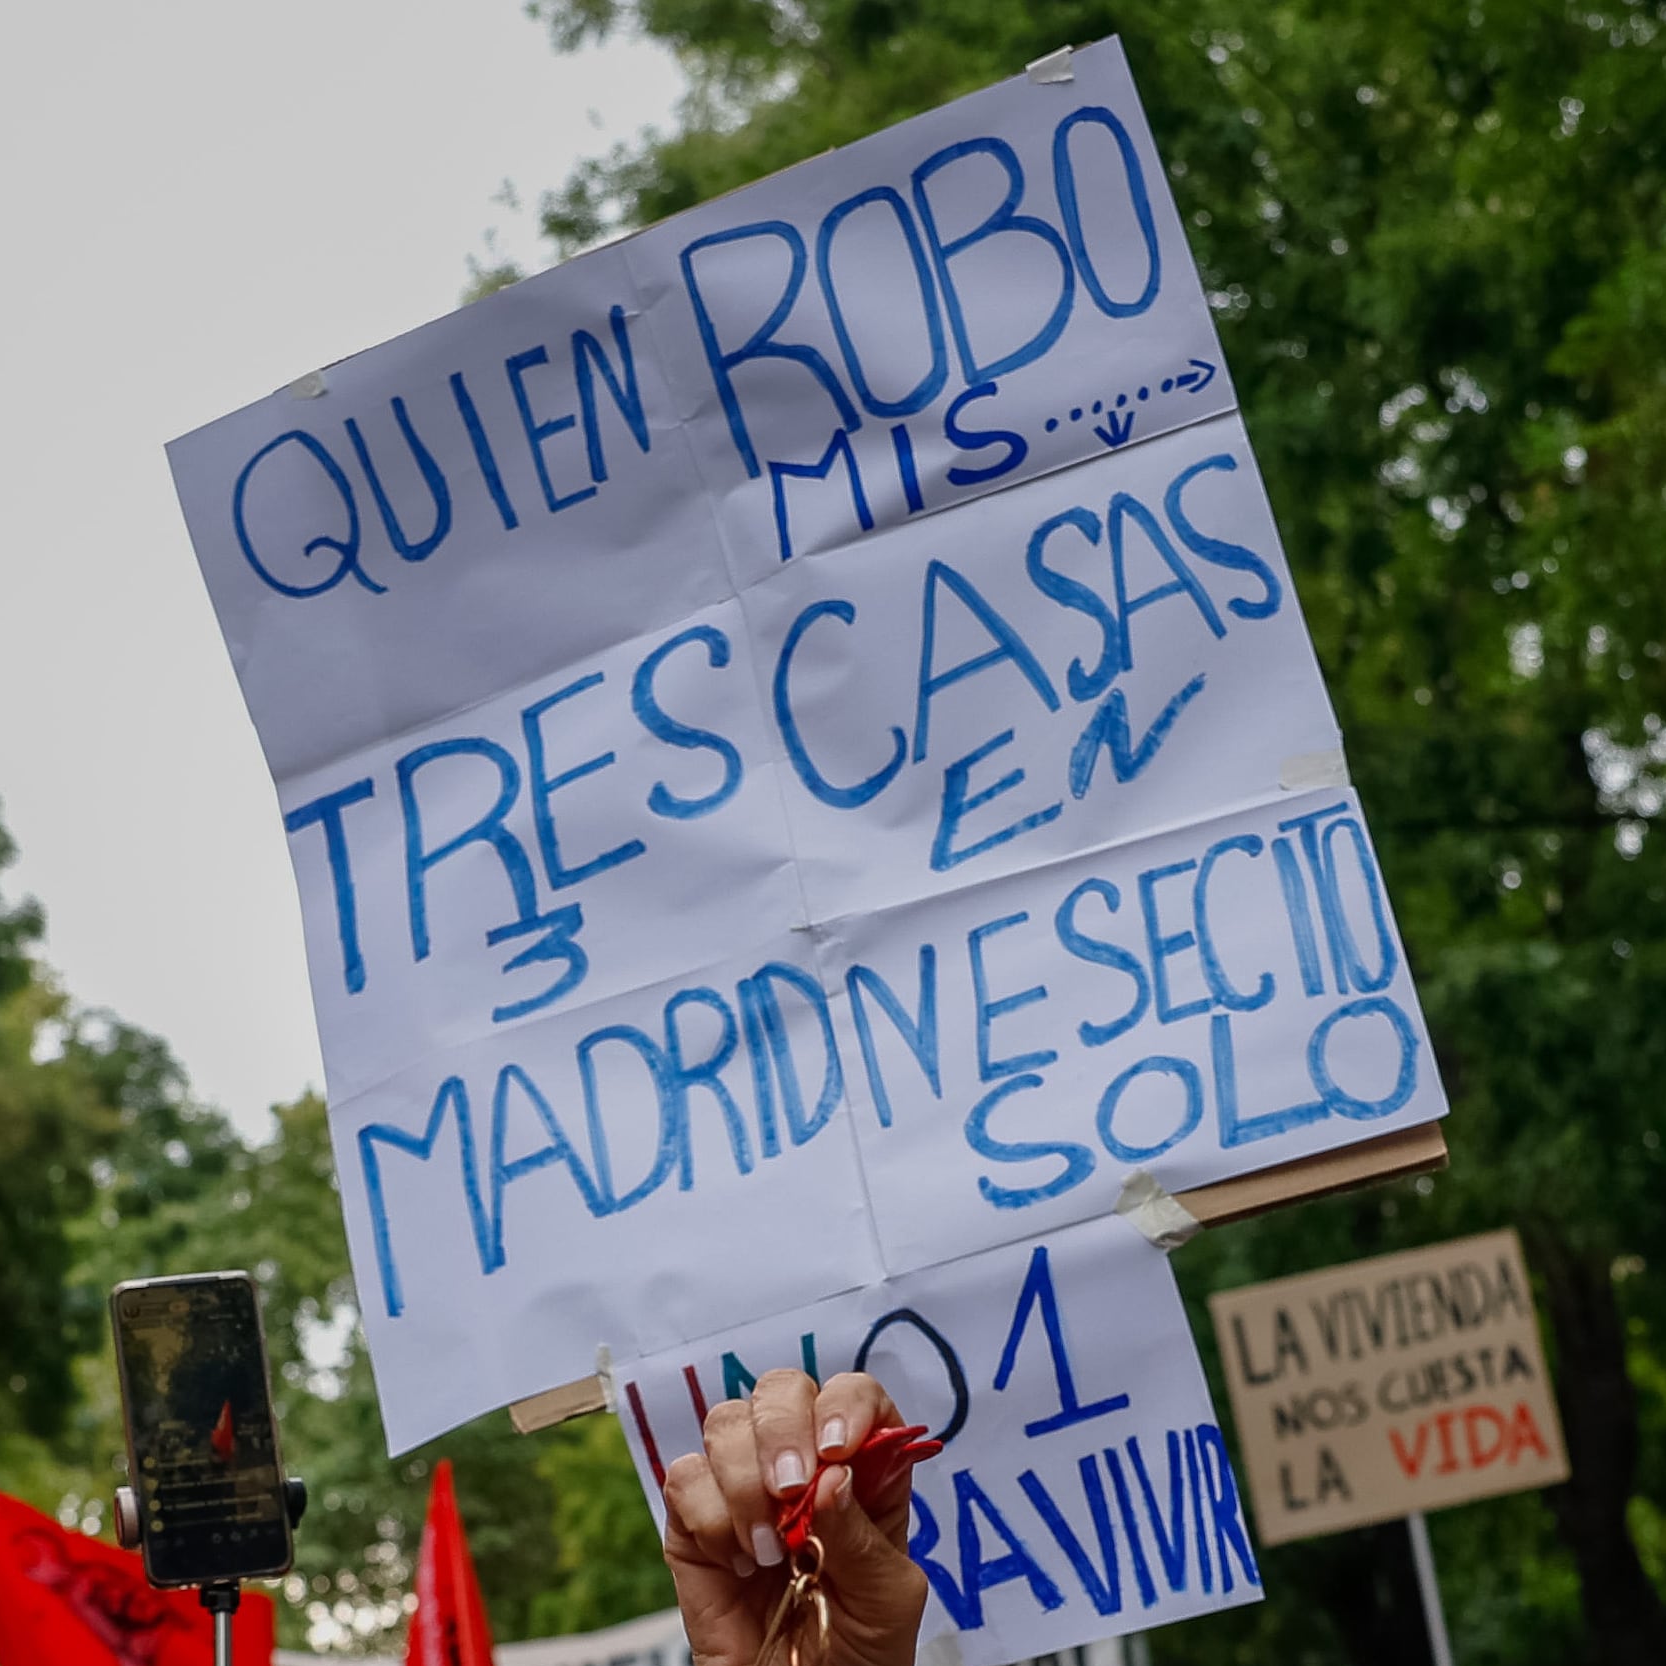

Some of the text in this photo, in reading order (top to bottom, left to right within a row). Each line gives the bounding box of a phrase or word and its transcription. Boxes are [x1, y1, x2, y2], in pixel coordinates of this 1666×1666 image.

[232, 105, 1162, 599] QUIEN ROBO
[769, 382, 1028, 560] MIS
[283, 454, 1284, 994] TRES CASAS
[929, 673, 1207, 873] EN
[489, 902, 588, 1022] 3
[358, 961, 846, 1317] MADRID
[965, 995, 1419, 1209] SOLO
[994, 1246, 1129, 1437] 1
[1233, 1256, 1527, 1386] LA VIVIENDA
[1273, 1344, 1532, 1440] NOS CUESTA
[907, 1422, 1261, 1631] RAVIVIR
[1279, 1401, 1550, 1512] LA VIDA
